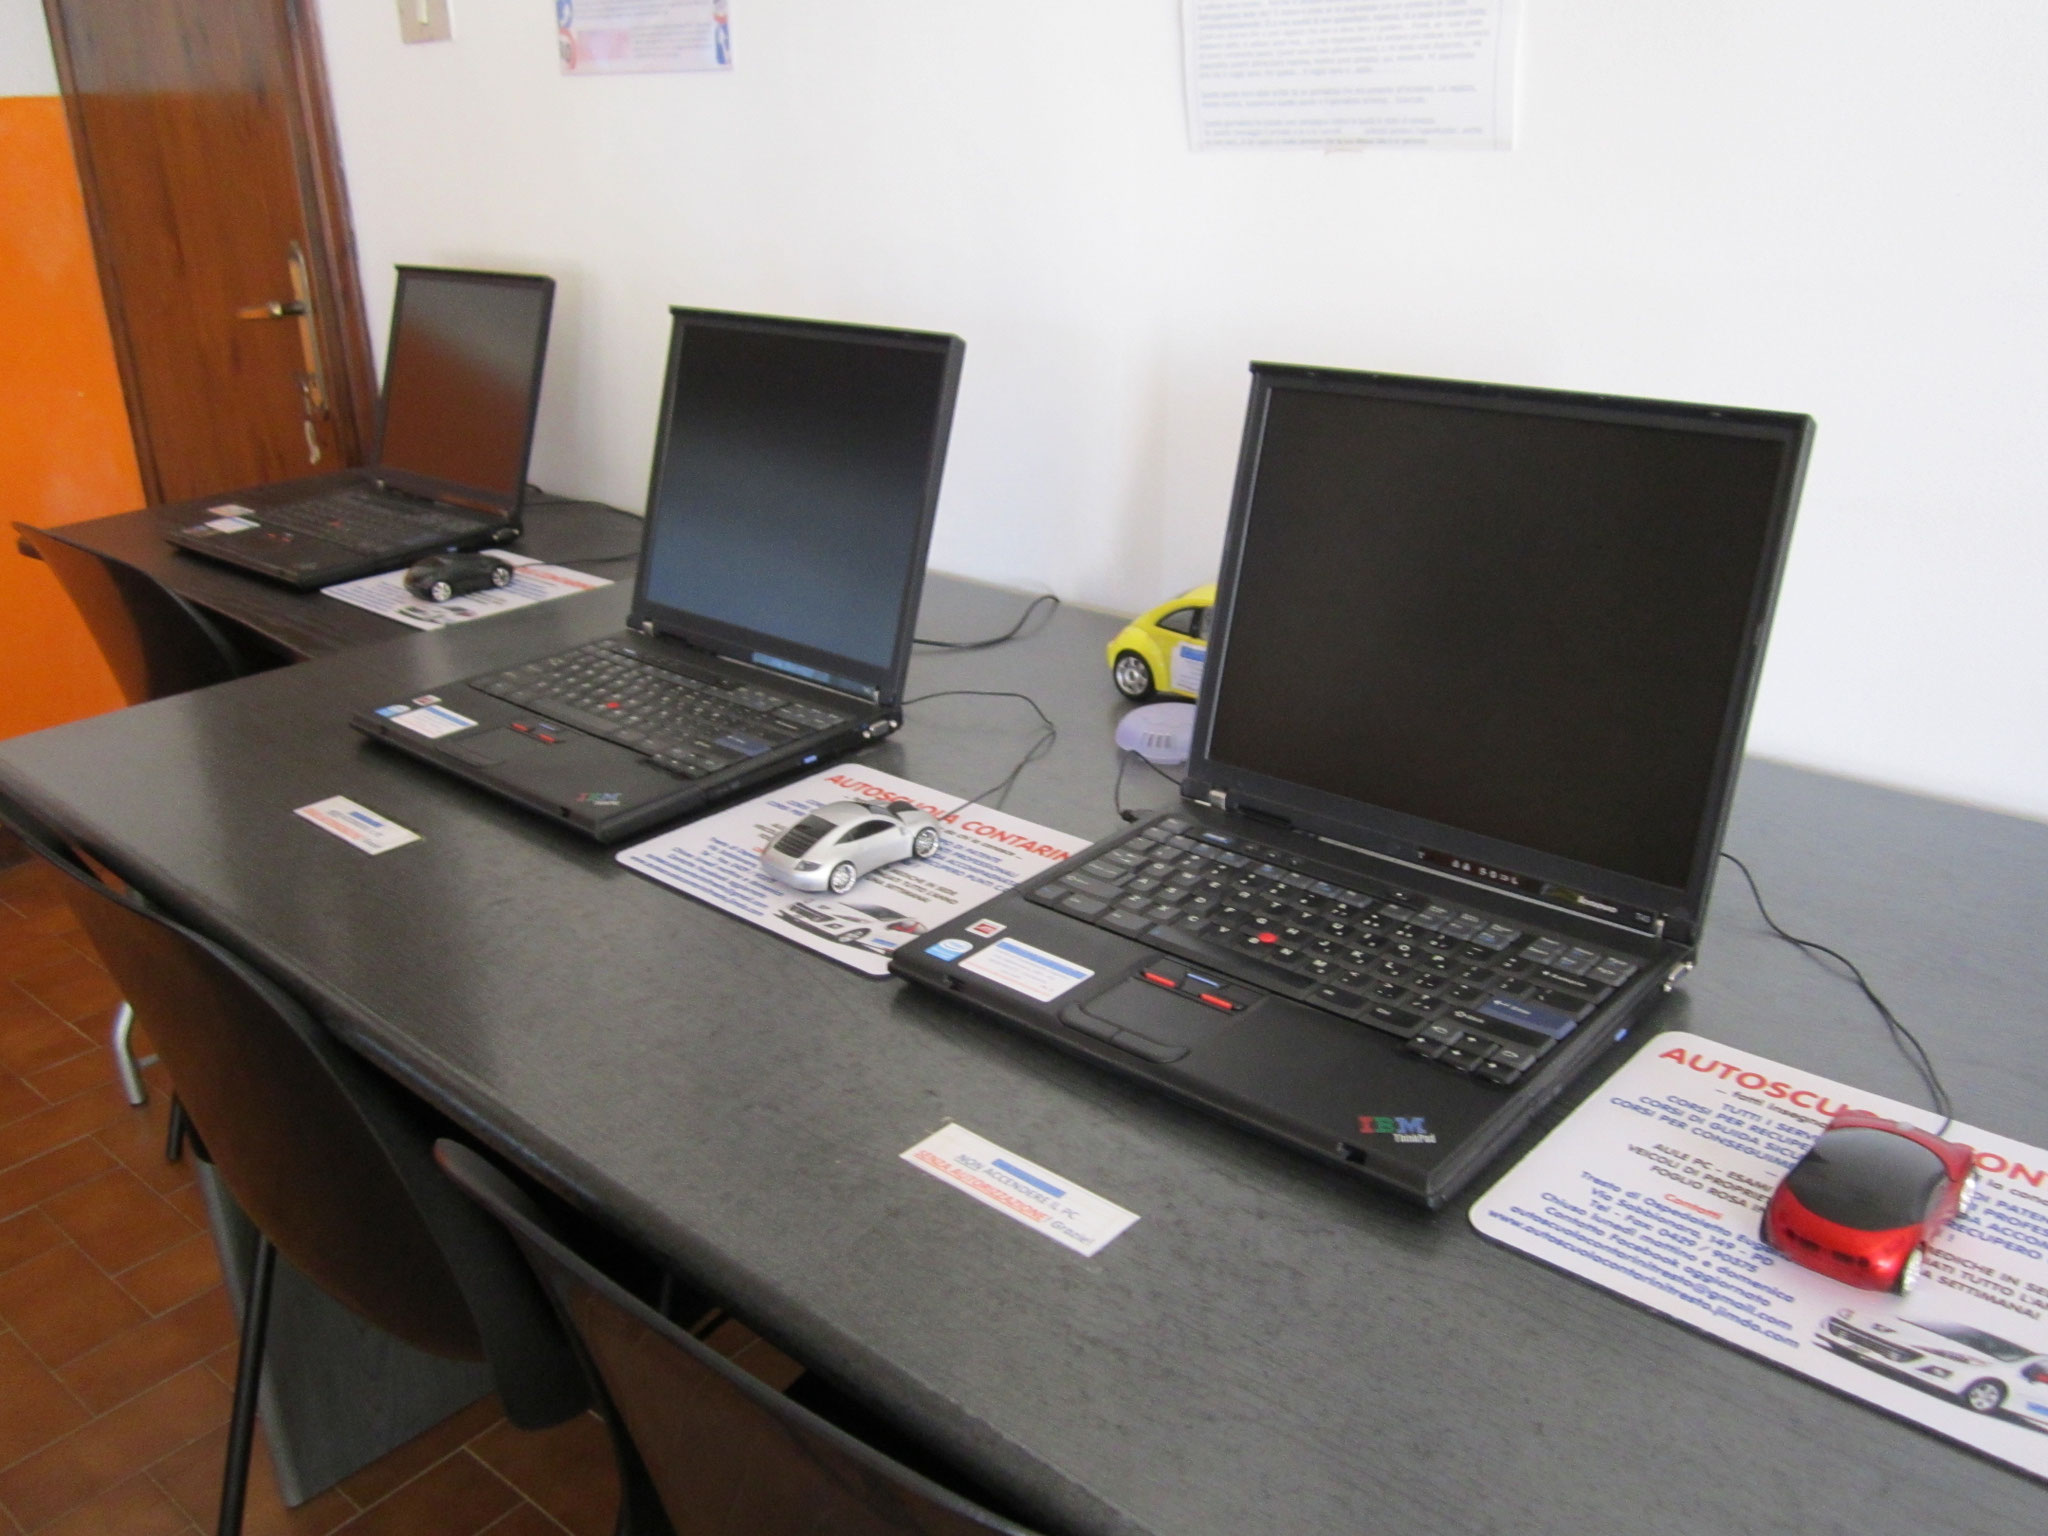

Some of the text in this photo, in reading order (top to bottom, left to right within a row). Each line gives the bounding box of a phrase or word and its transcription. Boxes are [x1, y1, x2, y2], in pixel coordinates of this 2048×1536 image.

[961, 821, 1071, 860] CONTARIN
[1659, 1047, 1864, 1118] AUTOSCU
[1358, 1115, 1427, 1134] IBM
[1609, 1096, 1657, 1117] CORSI
[1658, 1113, 1689, 1130] PER
[1638, 1095, 1685, 1117] CORSI
[1687, 1113, 1706, 1125] DI
[1709, 1121, 1760, 1146] GUIDA
[1763, 1141, 1808, 1162] SICU
[1666, 1094, 1714, 1116] CORSI
[1715, 1111, 1745, 1127] PER
[1748, 1123, 1813, 1152] RECUPE
[1721, 1102, 1763, 1122] TUTTI
[1627, 1143, 1681, 1169] VEICOLI
[1682, 1165, 1701, 1177] DI
[1652, 1143, 1691, 1162] AULE
[1692, 1156, 1715, 1171] PC
[1650, 1165, 1704, 1190] FOGLIO
[1706, 1187, 1748, 1208] ROSA
